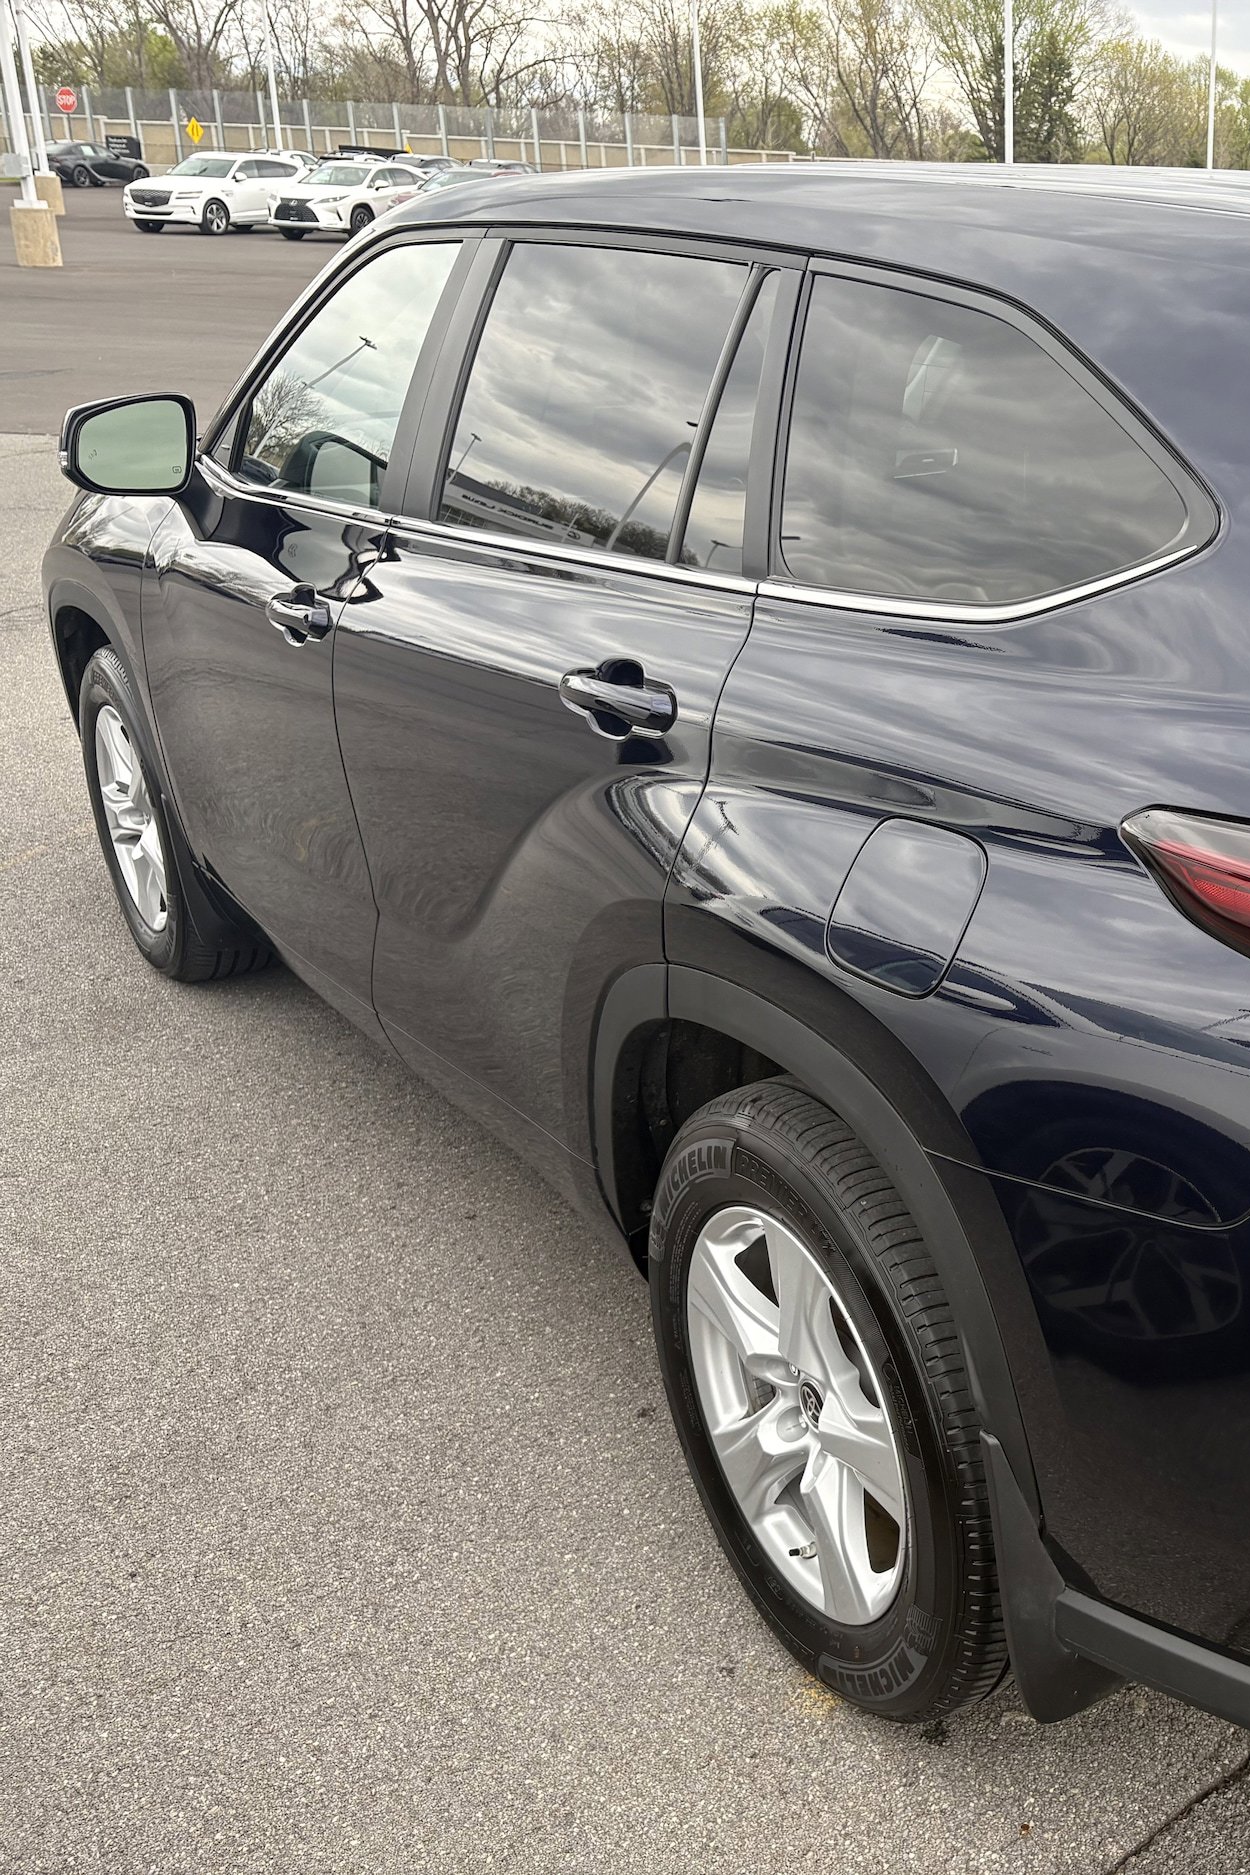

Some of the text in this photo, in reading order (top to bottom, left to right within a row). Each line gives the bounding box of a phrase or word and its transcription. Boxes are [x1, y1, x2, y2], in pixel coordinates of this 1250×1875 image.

[56, 94, 76, 106] STOP
[655, 1145, 728, 1219] MICHELIN
[822, 1646, 916, 1697] MICHELIN
